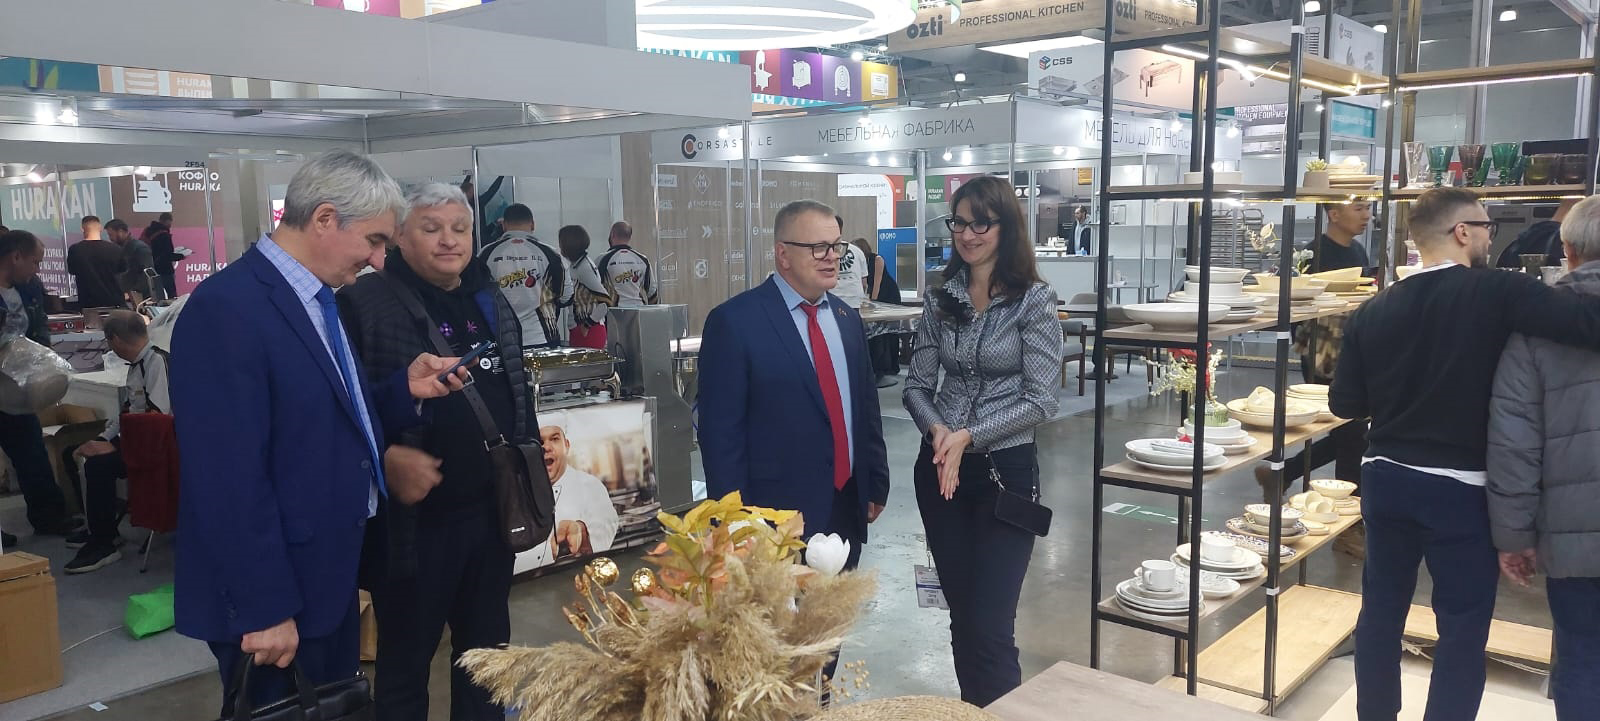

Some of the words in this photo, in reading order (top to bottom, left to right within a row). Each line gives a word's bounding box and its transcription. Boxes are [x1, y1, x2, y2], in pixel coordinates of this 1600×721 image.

[906, 14, 943, 40] ozti
[959, 11, 1036, 28] PROFESSIONAL
[1038, 2, 1085, 18] KITCHEN
[1052, 56, 1073, 66] CSS
[904, 118, 975, 137] ФАБРИКА
[1085, 119, 1135, 143] МЕЕЛЬ
[11, 183, 97, 220] HURAKAN
